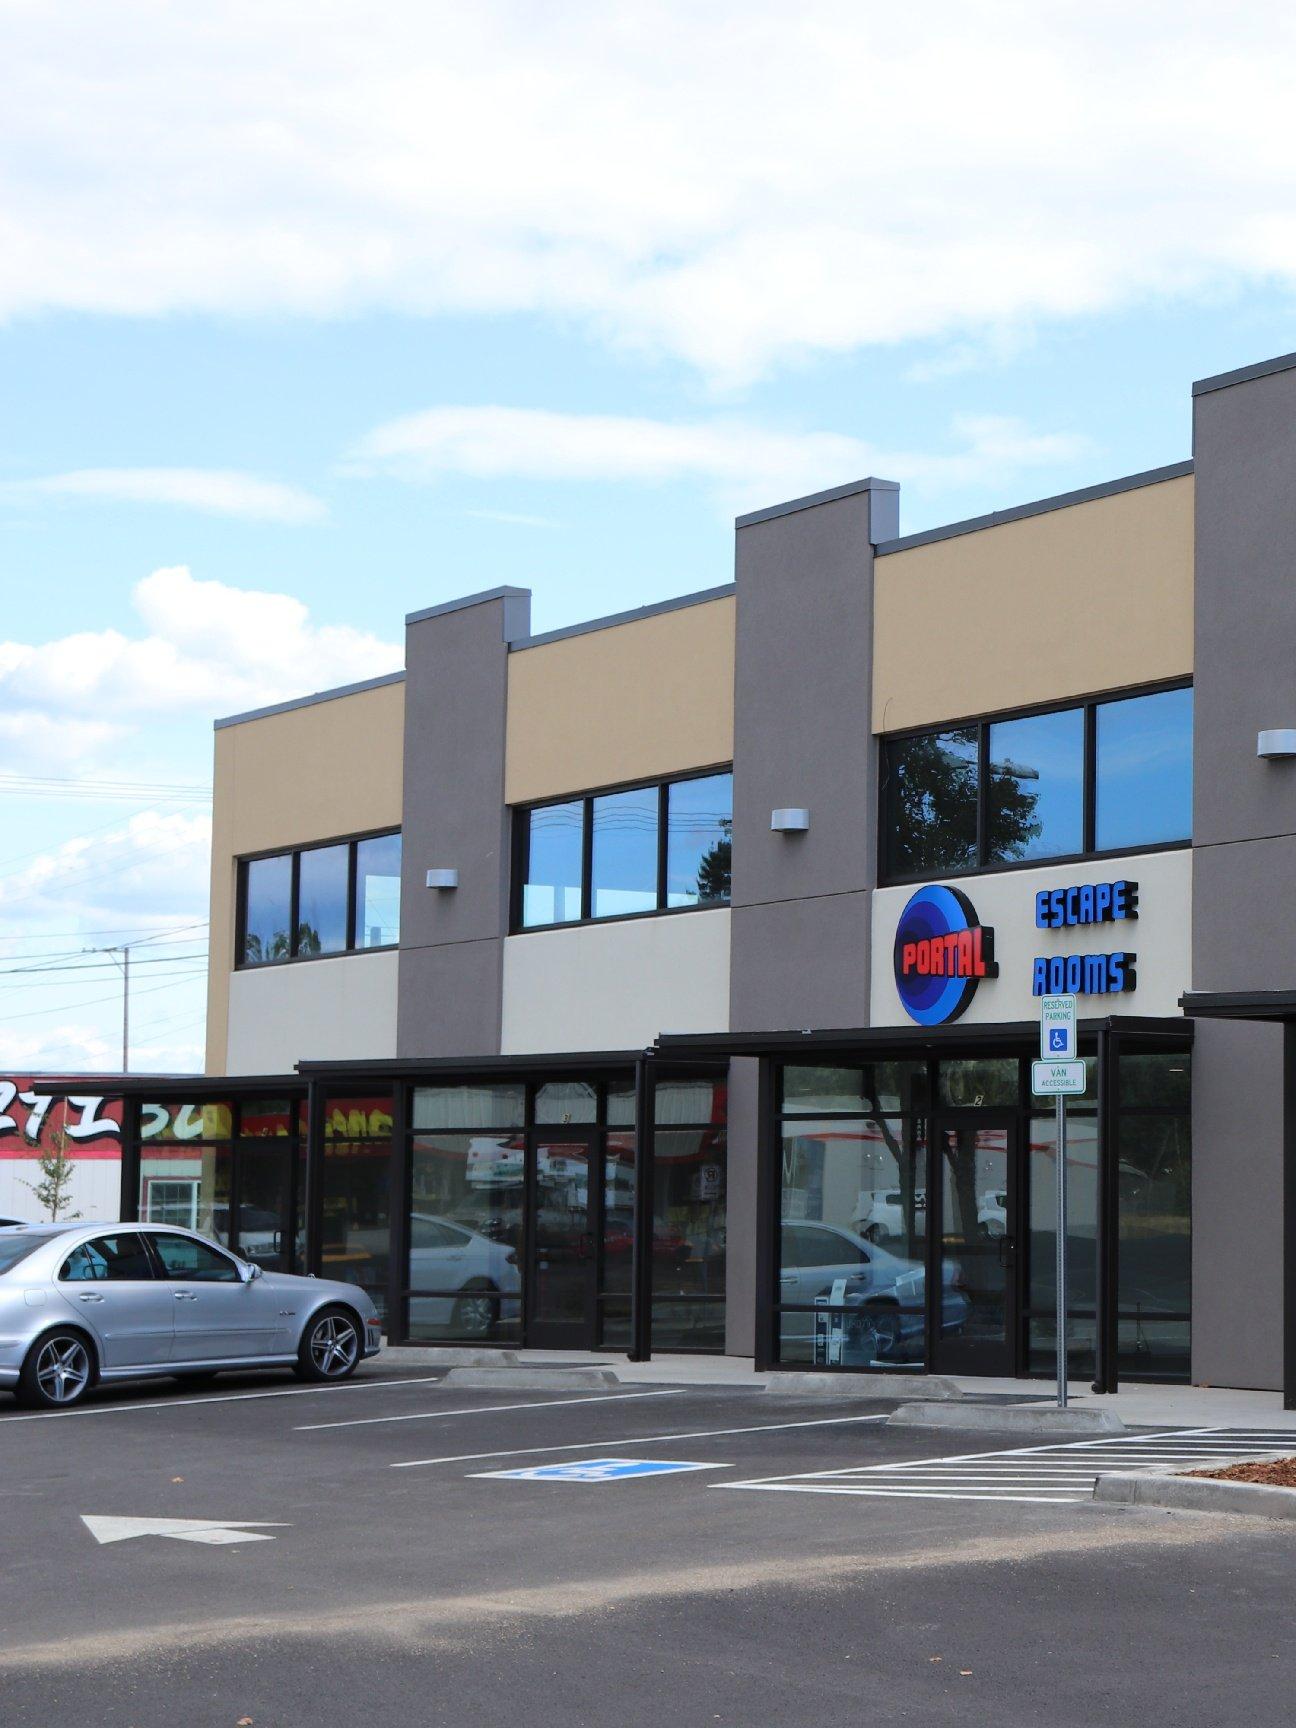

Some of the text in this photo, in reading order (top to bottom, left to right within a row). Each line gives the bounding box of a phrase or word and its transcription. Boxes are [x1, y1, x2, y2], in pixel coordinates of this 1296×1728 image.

[1035, 880, 1128, 929] ESCAPE
[903, 928, 986, 977] PORTAL
[1032, 952, 1126, 997] ROOMS
[1043, 1000, 1073, 1010] RESERVED
[1045, 1012, 1071, 1021] PARKING
[1051, 1068, 1067, 1077] VAN
